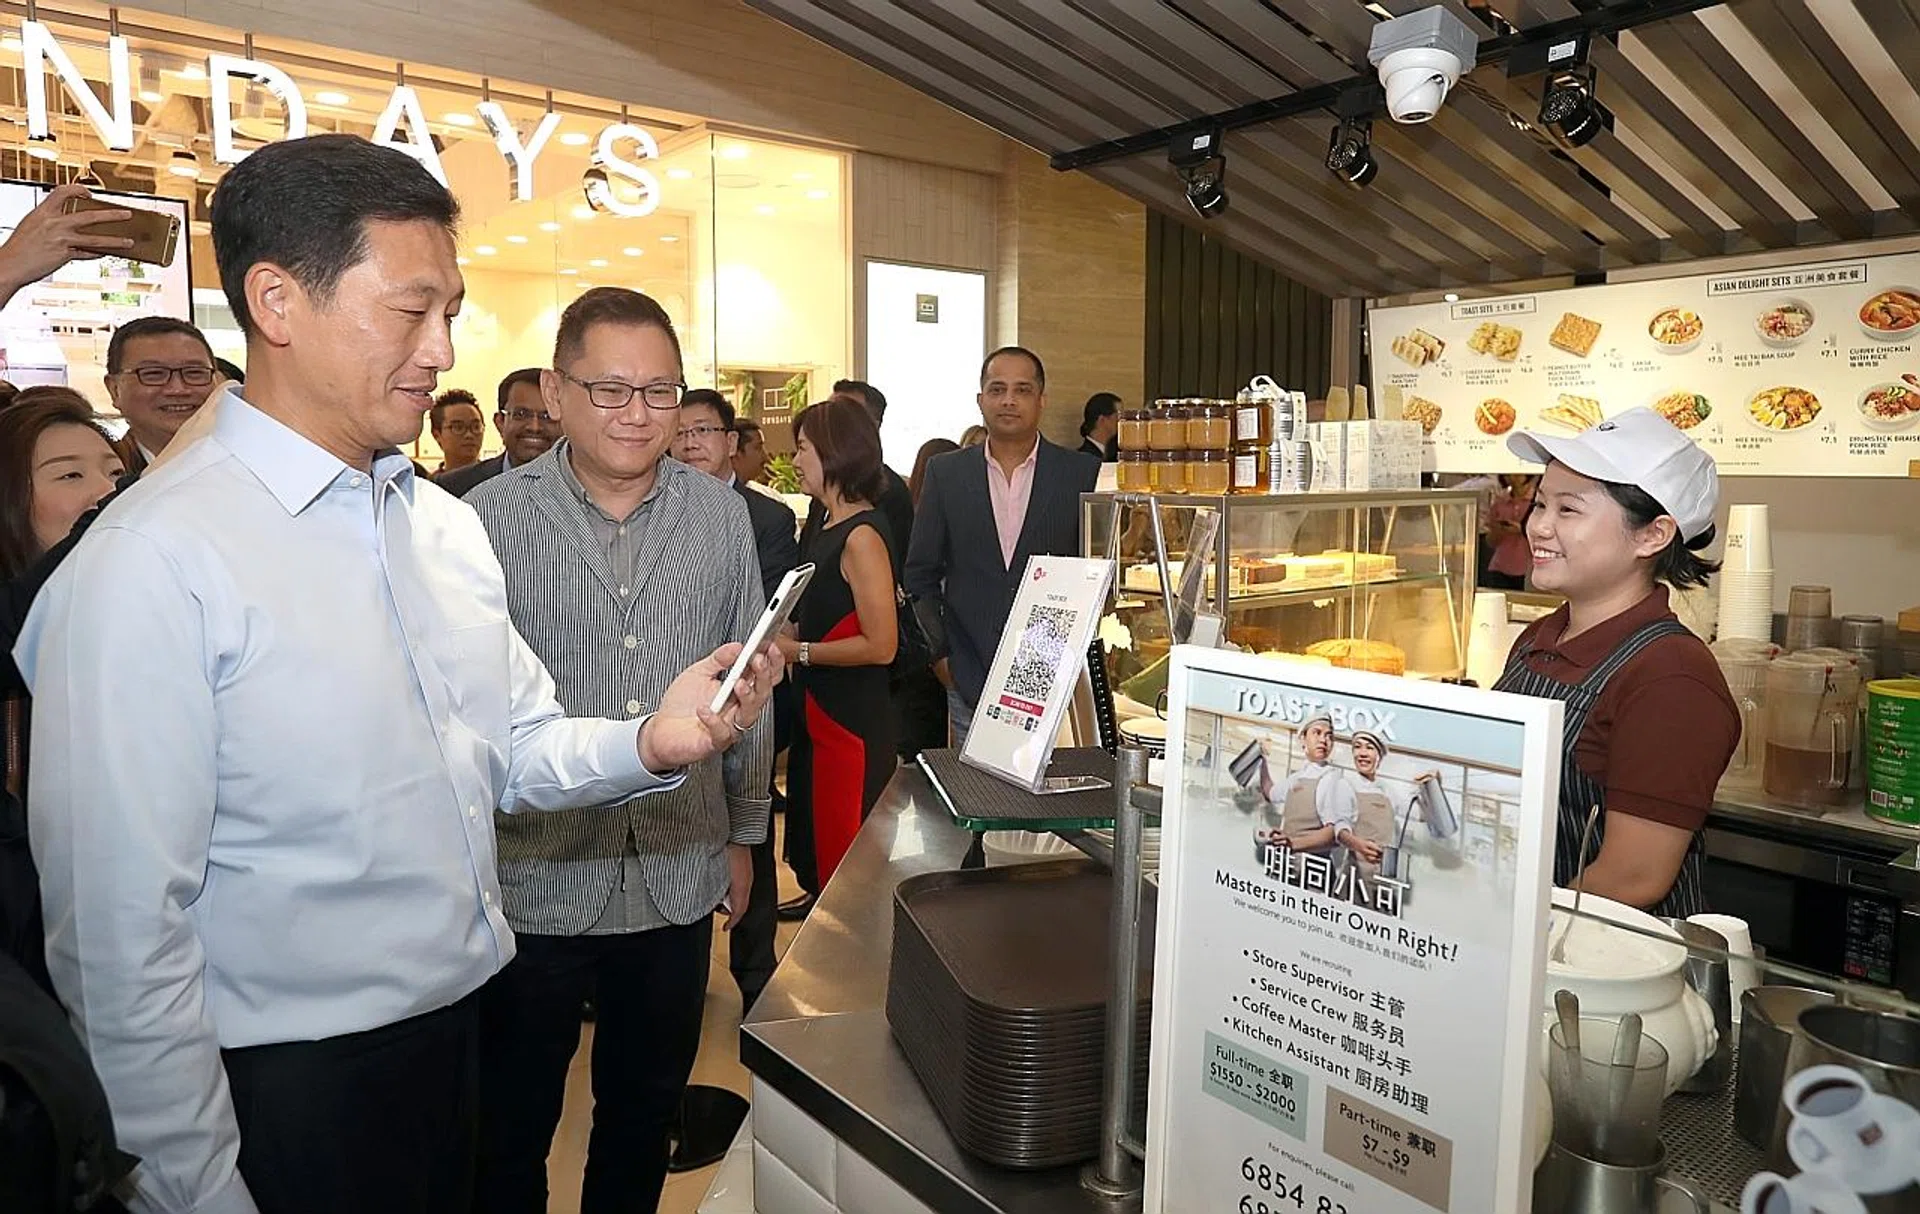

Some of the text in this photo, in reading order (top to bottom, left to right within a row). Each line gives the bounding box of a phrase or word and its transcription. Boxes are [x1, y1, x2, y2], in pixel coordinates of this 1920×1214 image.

[1713, 275, 1791, 292] ASIAN DELIGHT SETS
[1876, 345, 1911, 354] CHICKEN
[1232, 686, 1398, 742] TOAST BOX
[1215, 869, 1458, 961] Masters in their Own Right!
[1233, 898, 1246, 909] We
[1247, 903, 1280, 919] welcome
[1282, 914, 1296, 926] you
[1297, 919, 1307, 929] to
[1307, 923, 1323, 935] join
[1252, 949, 1364, 1003] Store Supervisor
[1241, 996, 1336, 1045] Coffee Master
[1260, 977, 1348, 1023] Service Crew
[1370, 991, 1405, 1019] 主管
[1232, 1017, 1350, 1080] Kitchen Assistant
[1352, 1011, 1404, 1048] 服务员
[1216, 1045, 1265, 1078] Full-time
[1340, 1034, 1412, 1077] 咖啡头手
[1210, 1061, 1244, 1088] $1550
[1255, 1082, 1296, 1113] $2000
[1269, 1068, 1294, 1091] 全职
[1354, 1067, 1429, 1115] 厨房助理
[1339, 1102, 1401, 1141] Part-time
[1268, 1142, 1280, 1153] For
[1315, 1167, 1339, 1184] please
[1362, 1134, 1379, 1152] $7
[1392, 1148, 1410, 1167] $9
[1241, 1156, 1304, 1209] 6854
